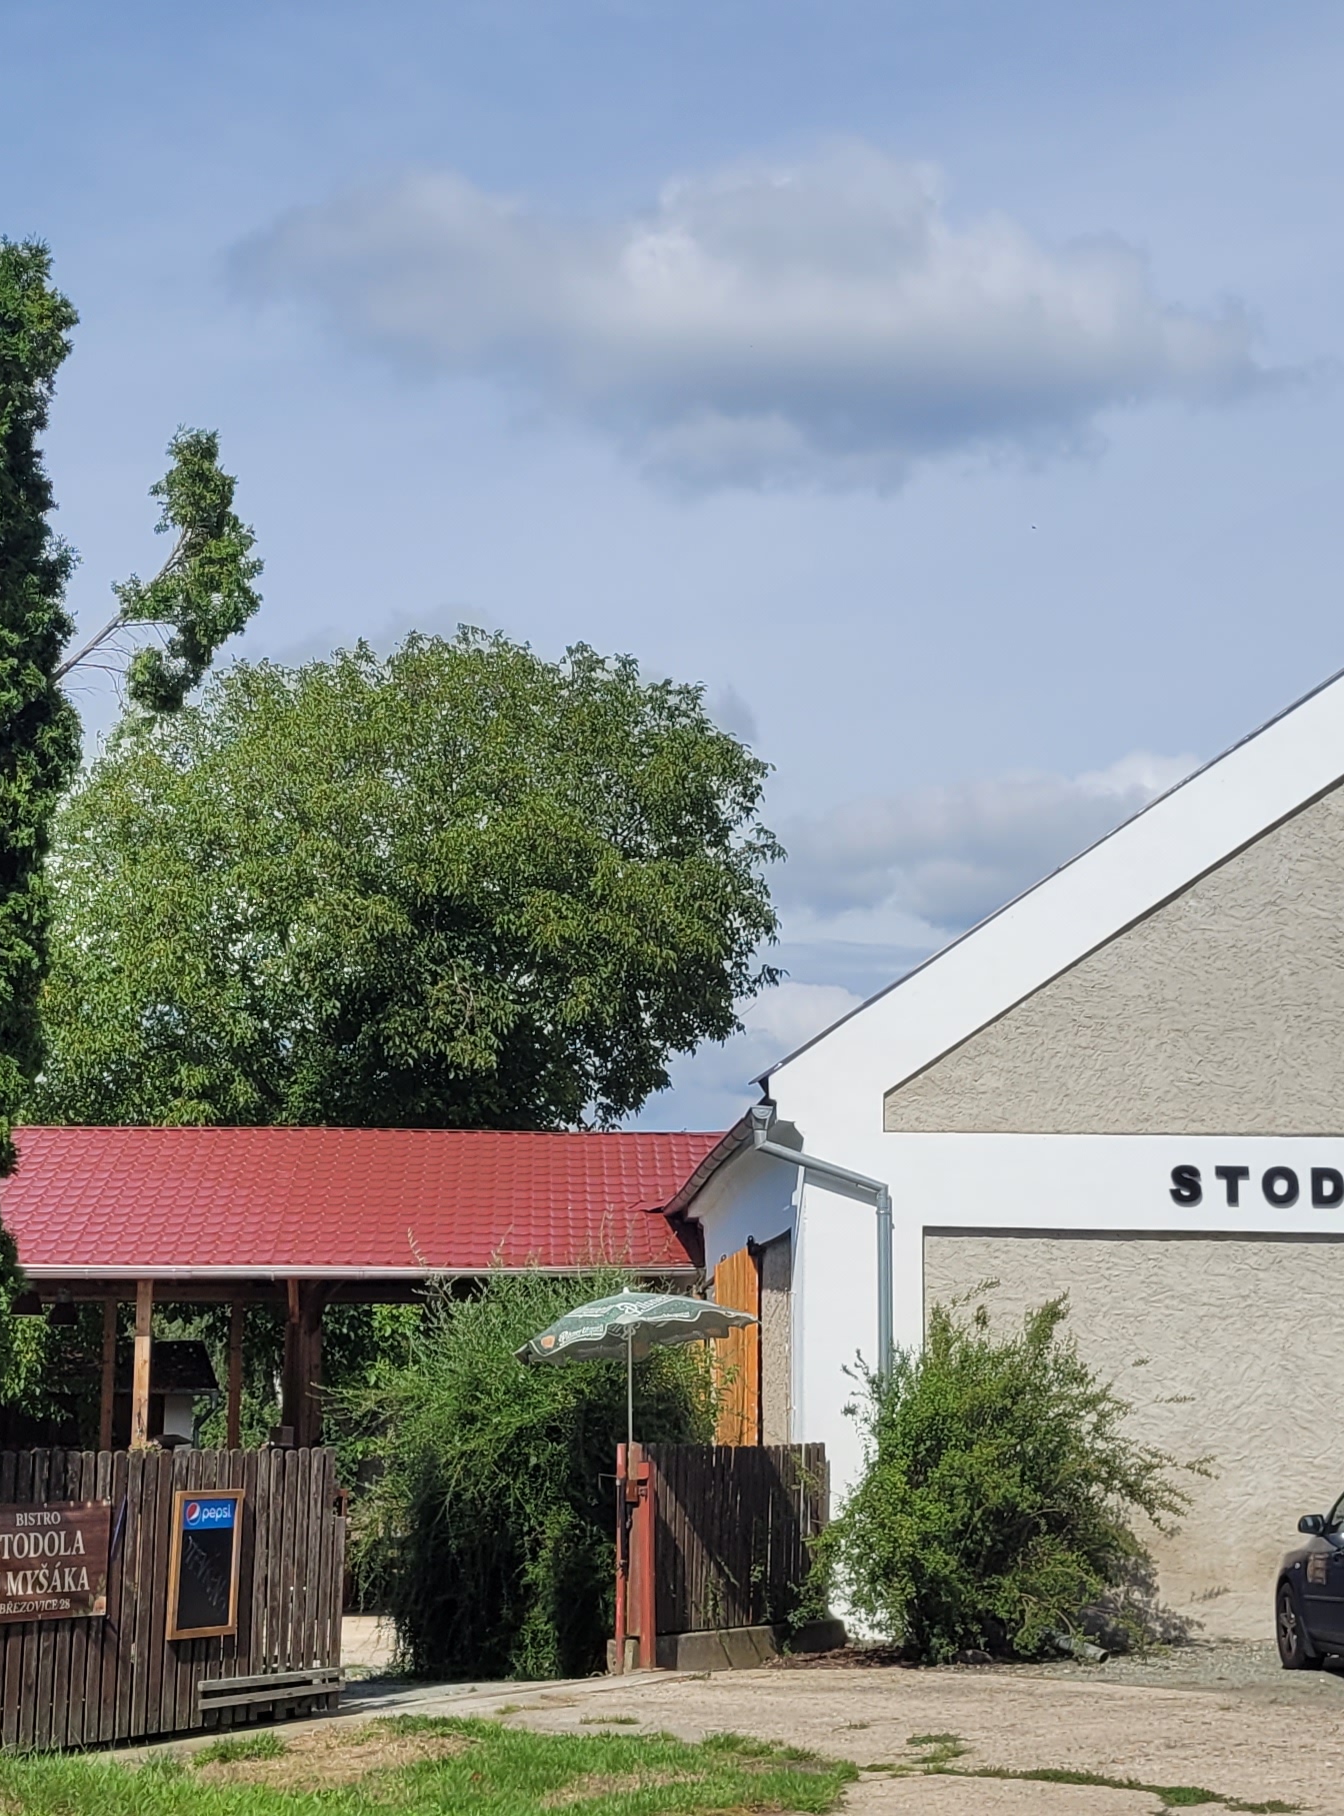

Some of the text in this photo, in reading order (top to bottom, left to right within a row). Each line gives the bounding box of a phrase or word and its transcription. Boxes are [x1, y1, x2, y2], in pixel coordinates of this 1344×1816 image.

[15, 1511, 61, 1527] BISTRO
[201, 1504, 232, 1522] pepsi
[5, 1561, 91, 1597] MYŠÁKA
[59, 1598, 71, 1610] 28
